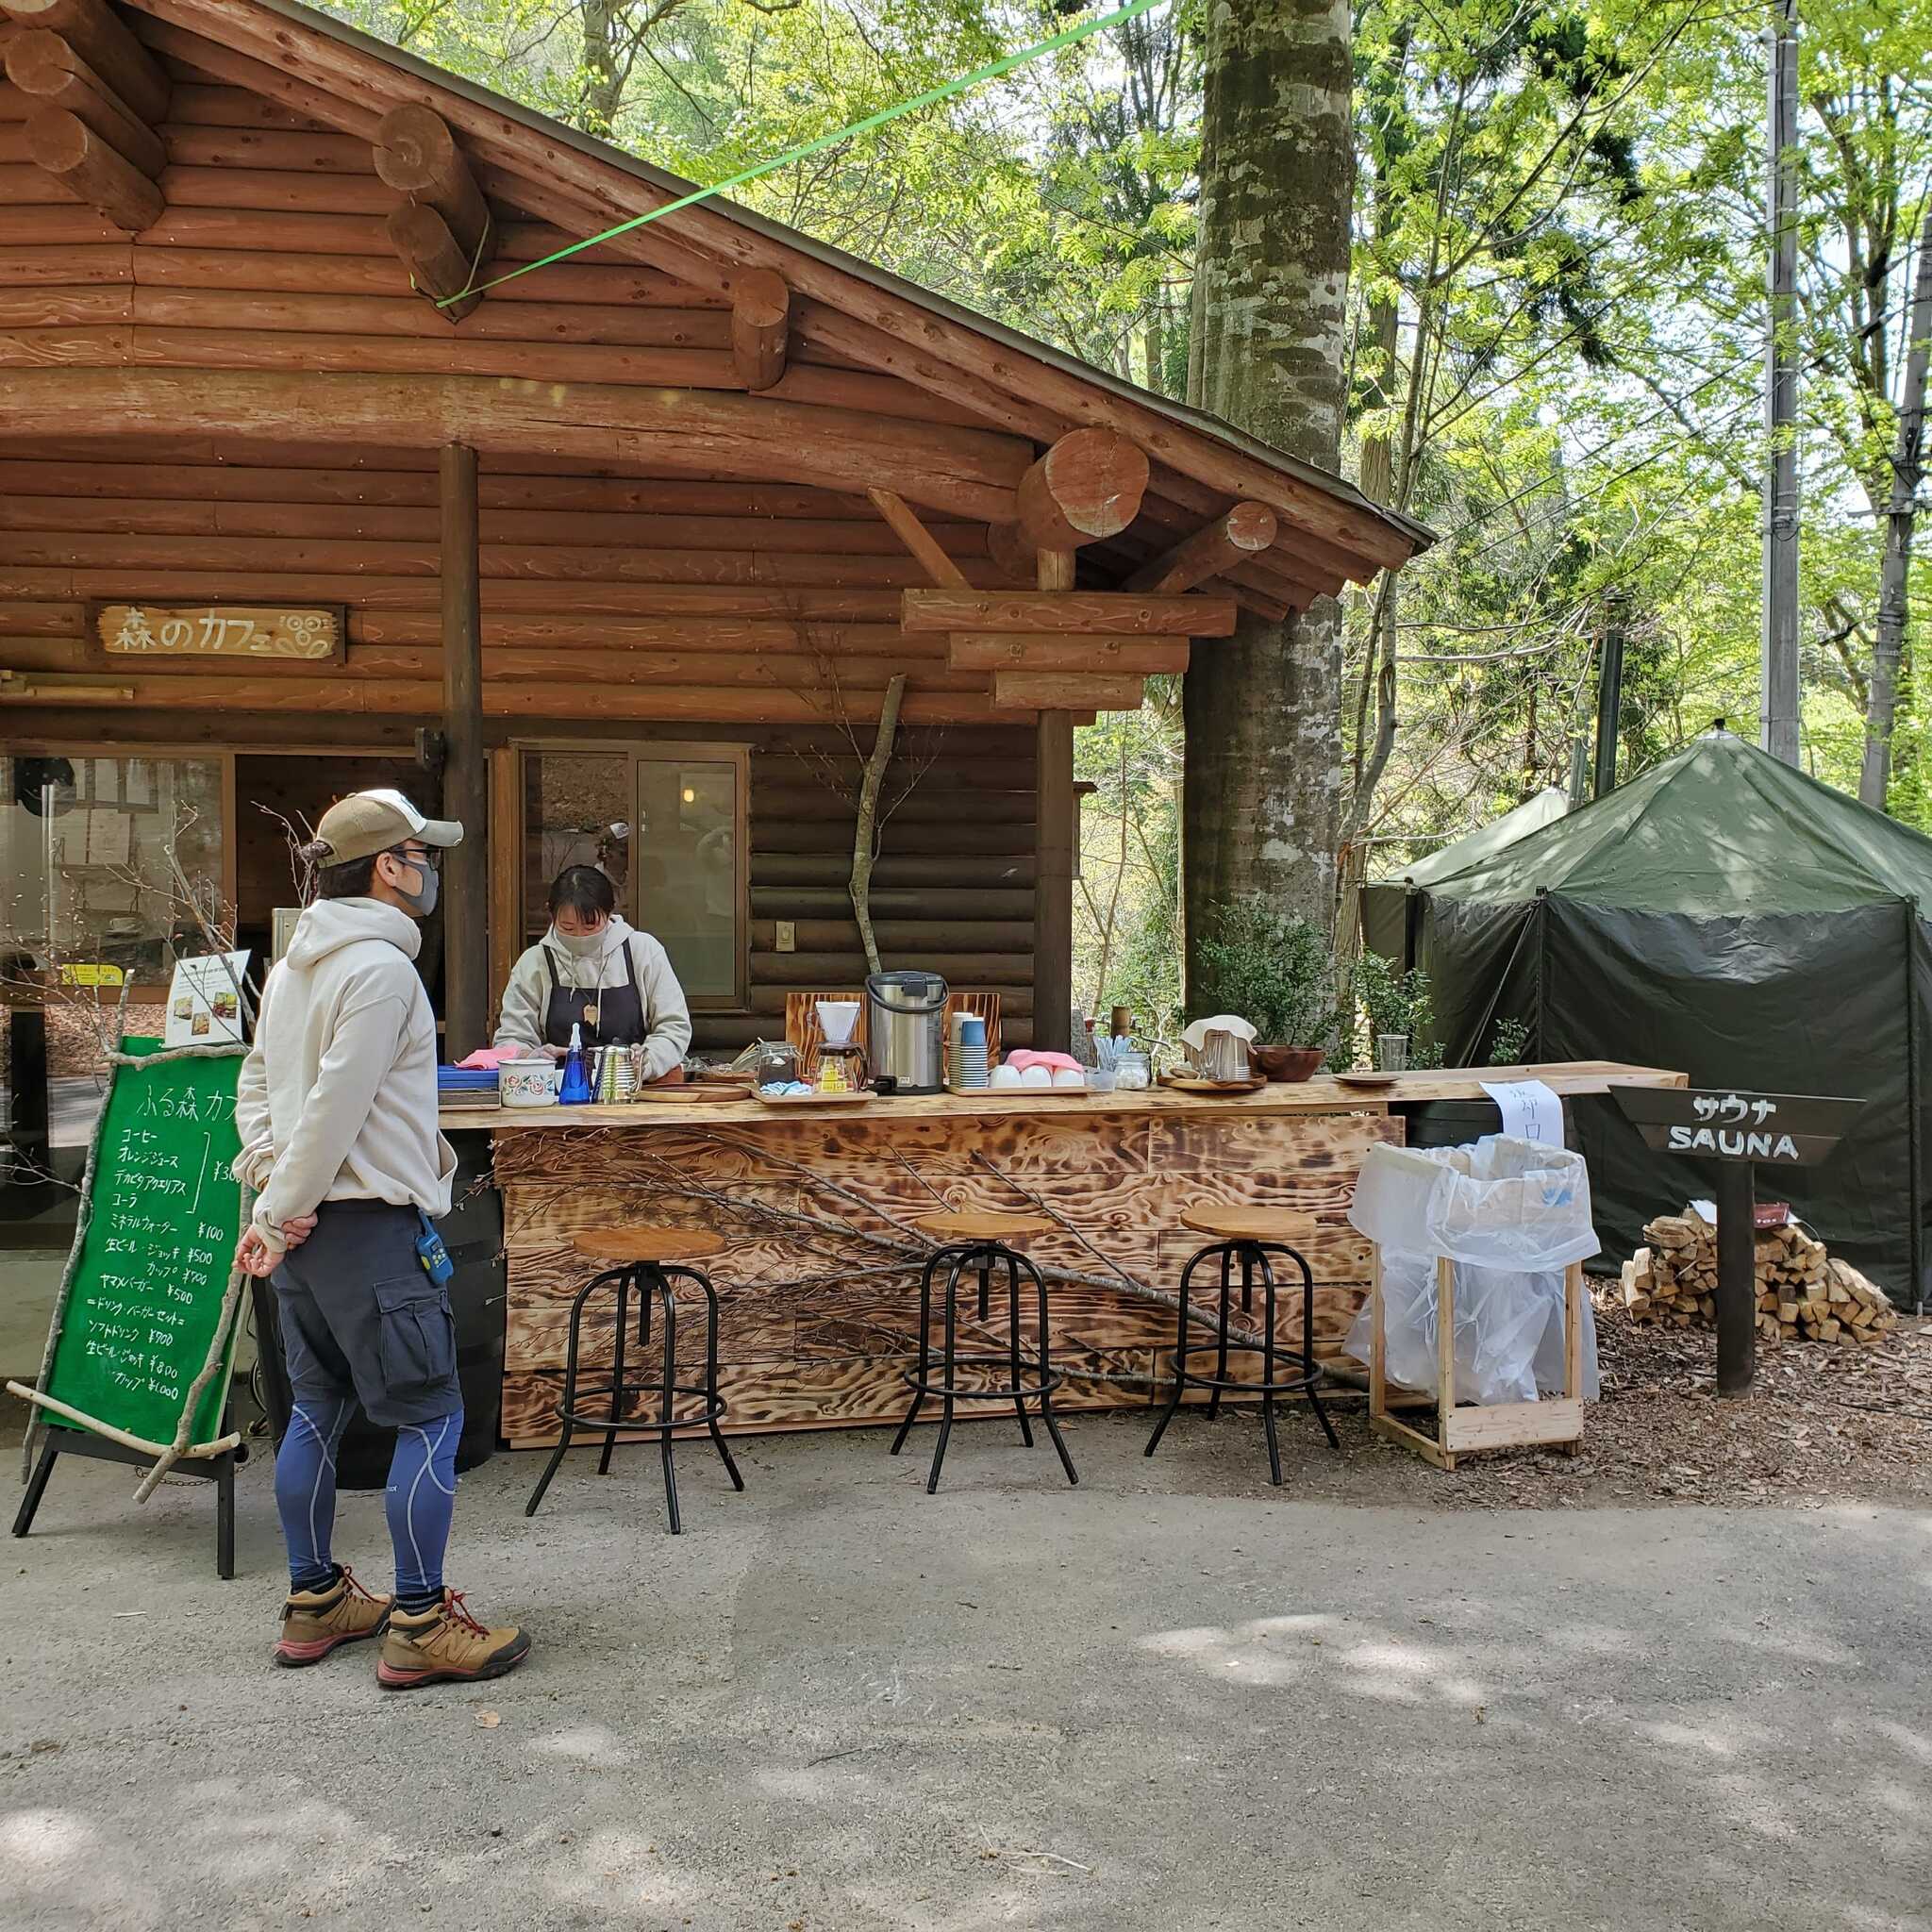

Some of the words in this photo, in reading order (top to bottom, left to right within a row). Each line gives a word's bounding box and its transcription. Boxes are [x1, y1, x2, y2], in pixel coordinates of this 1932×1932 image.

[113, 607, 272, 651] 森のカフェ
[1693, 1093, 1776, 1125] サウナ
[121, 1128, 158, 1143] コーヒー
[1668, 1125, 1799, 1160] SAUNA
[117, 1145, 179, 1169] オレンジジュース
[112, 1192, 138, 1208] コーラ
[110, 1213, 178, 1234] ミネラルウォーター
[196, 1222, 224, 1241] ¥100
[188, 1247, 213, 1265] ¥500
[146, 1260, 178, 1277] カップ
[166, 1283, 193, 1305] ¥500
[89, 1320, 140, 1341] ソフトドリンク
[148, 1328, 174, 1346] ¥700
[149, 1354, 178, 1379] ¥800
